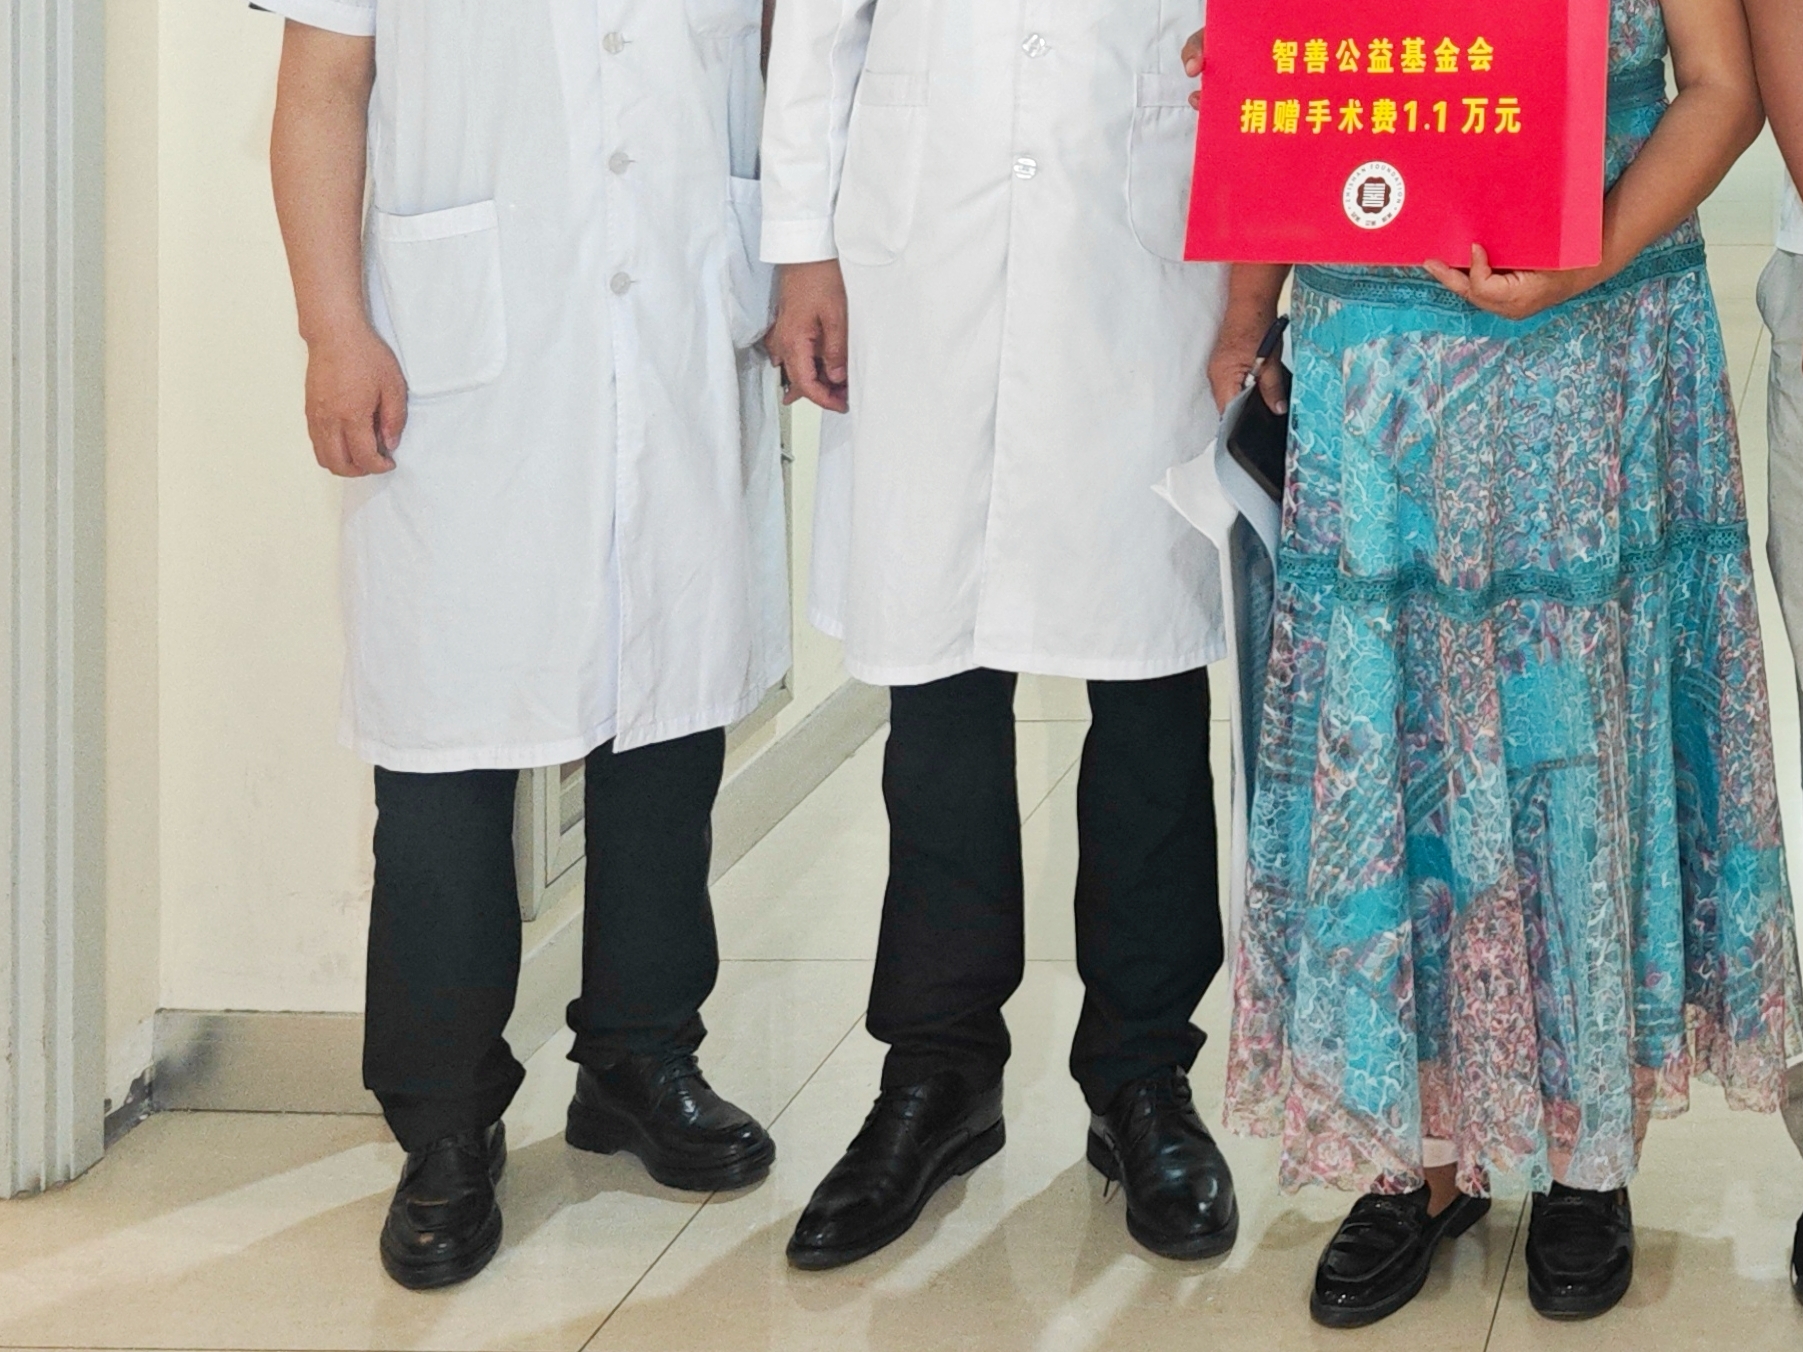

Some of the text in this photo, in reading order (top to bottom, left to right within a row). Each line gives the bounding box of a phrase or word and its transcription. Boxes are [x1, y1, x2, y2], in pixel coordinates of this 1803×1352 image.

[1272, 36, 1494, 74] 智善公益基金会
[1240, 97, 1522, 134] 捐赠手术费1.1万元
